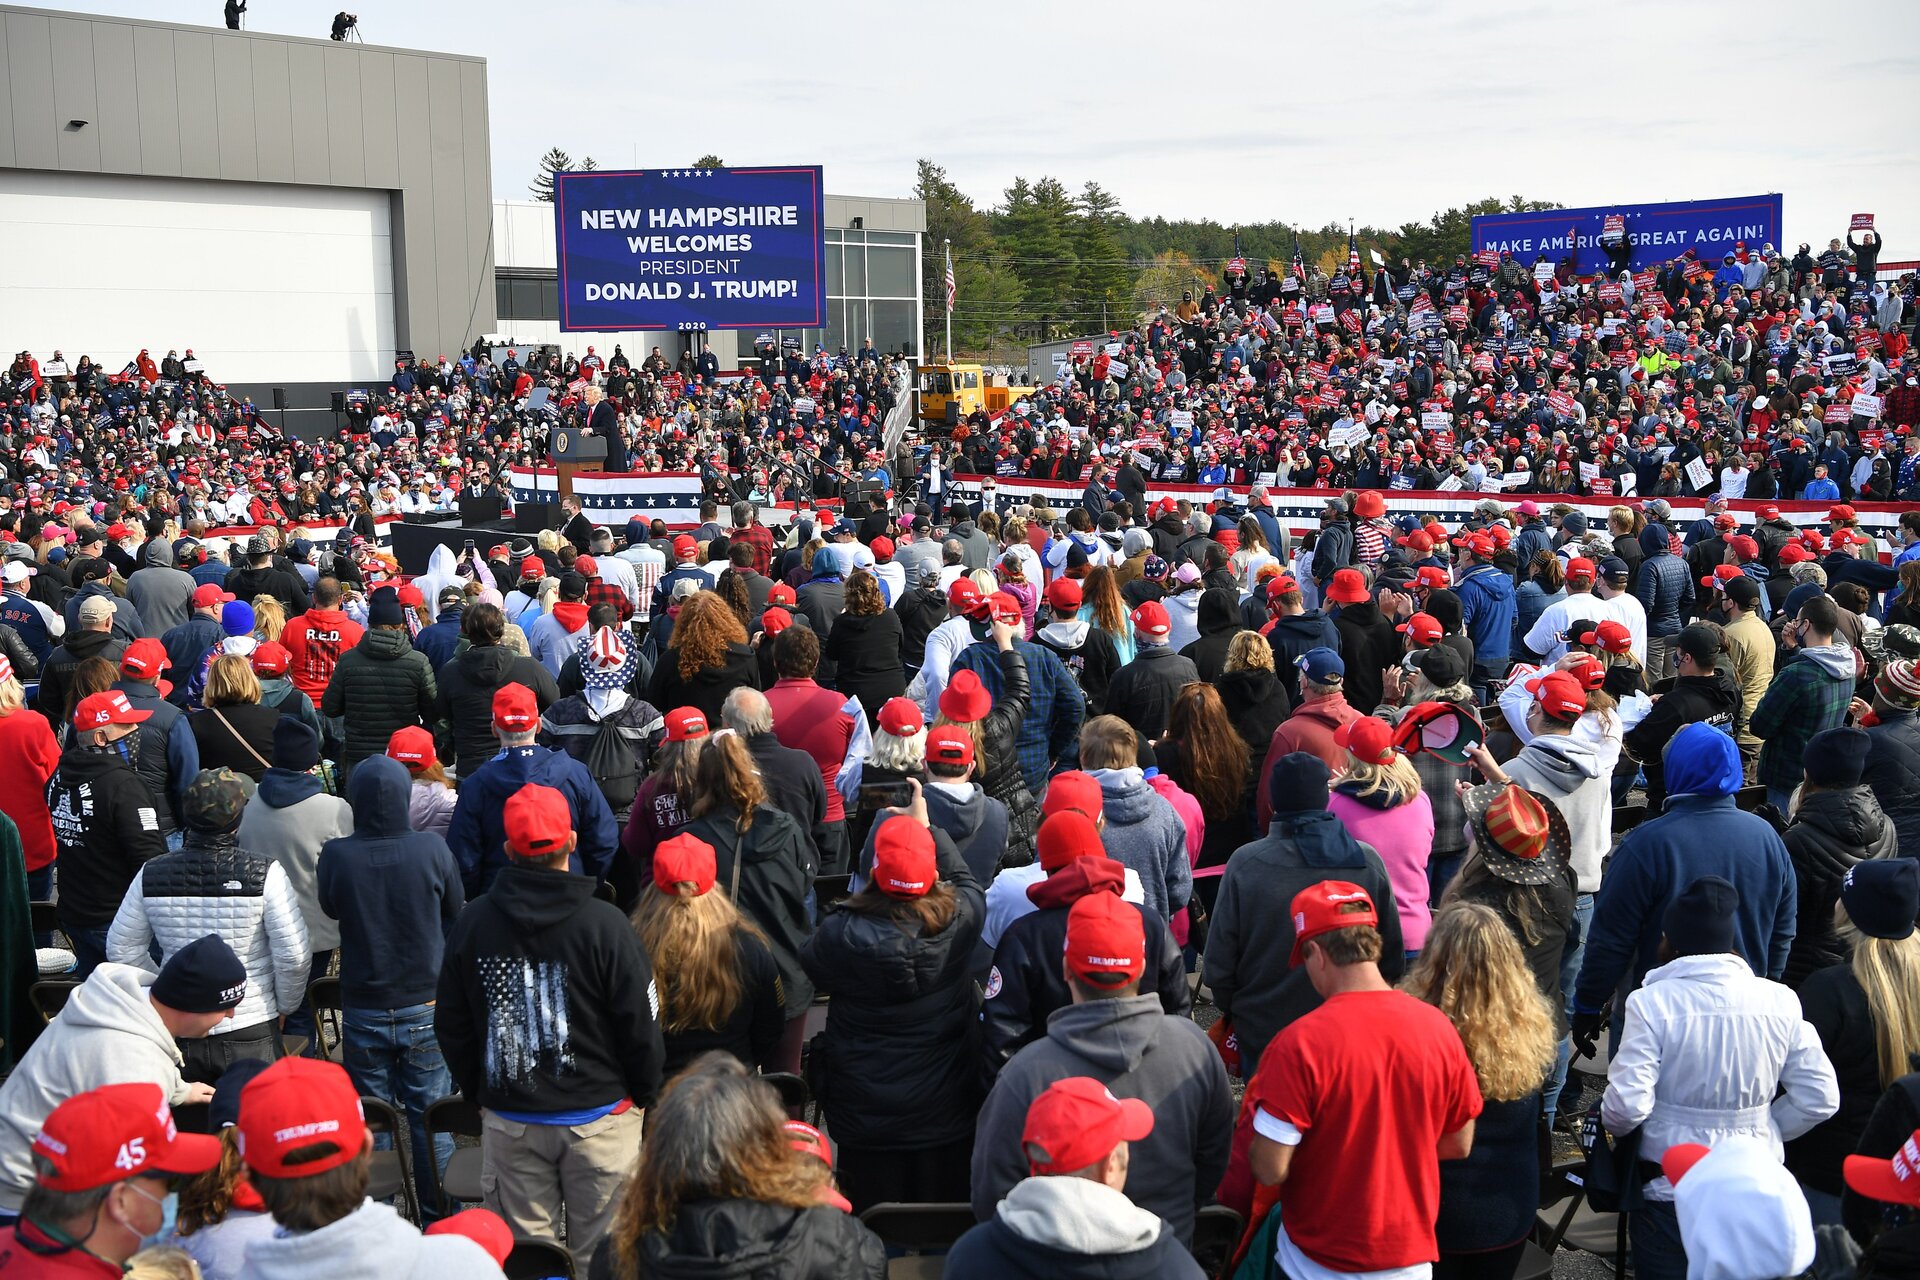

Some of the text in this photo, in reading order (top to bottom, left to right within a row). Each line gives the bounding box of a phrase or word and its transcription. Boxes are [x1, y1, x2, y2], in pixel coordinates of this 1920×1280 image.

[581, 205, 798, 230] NEW HAMPSHIRE
[627, 234, 752, 253] WELCOMES
[1486, 224, 1764, 253] MAKE AMERIC GREAT AGAIN!
[640, 259, 740, 275] PRESIDENT
[585, 279, 798, 301] DONALD J. TRUMP!
[678, 322, 706, 330] 2020
[5, 609, 31, 623] SOX
[305, 628, 342, 642] R.E.D.
[95, 709, 110, 723] 45
[78, 782, 94, 817] ON ME
[115, 1136, 147, 1171] 45
